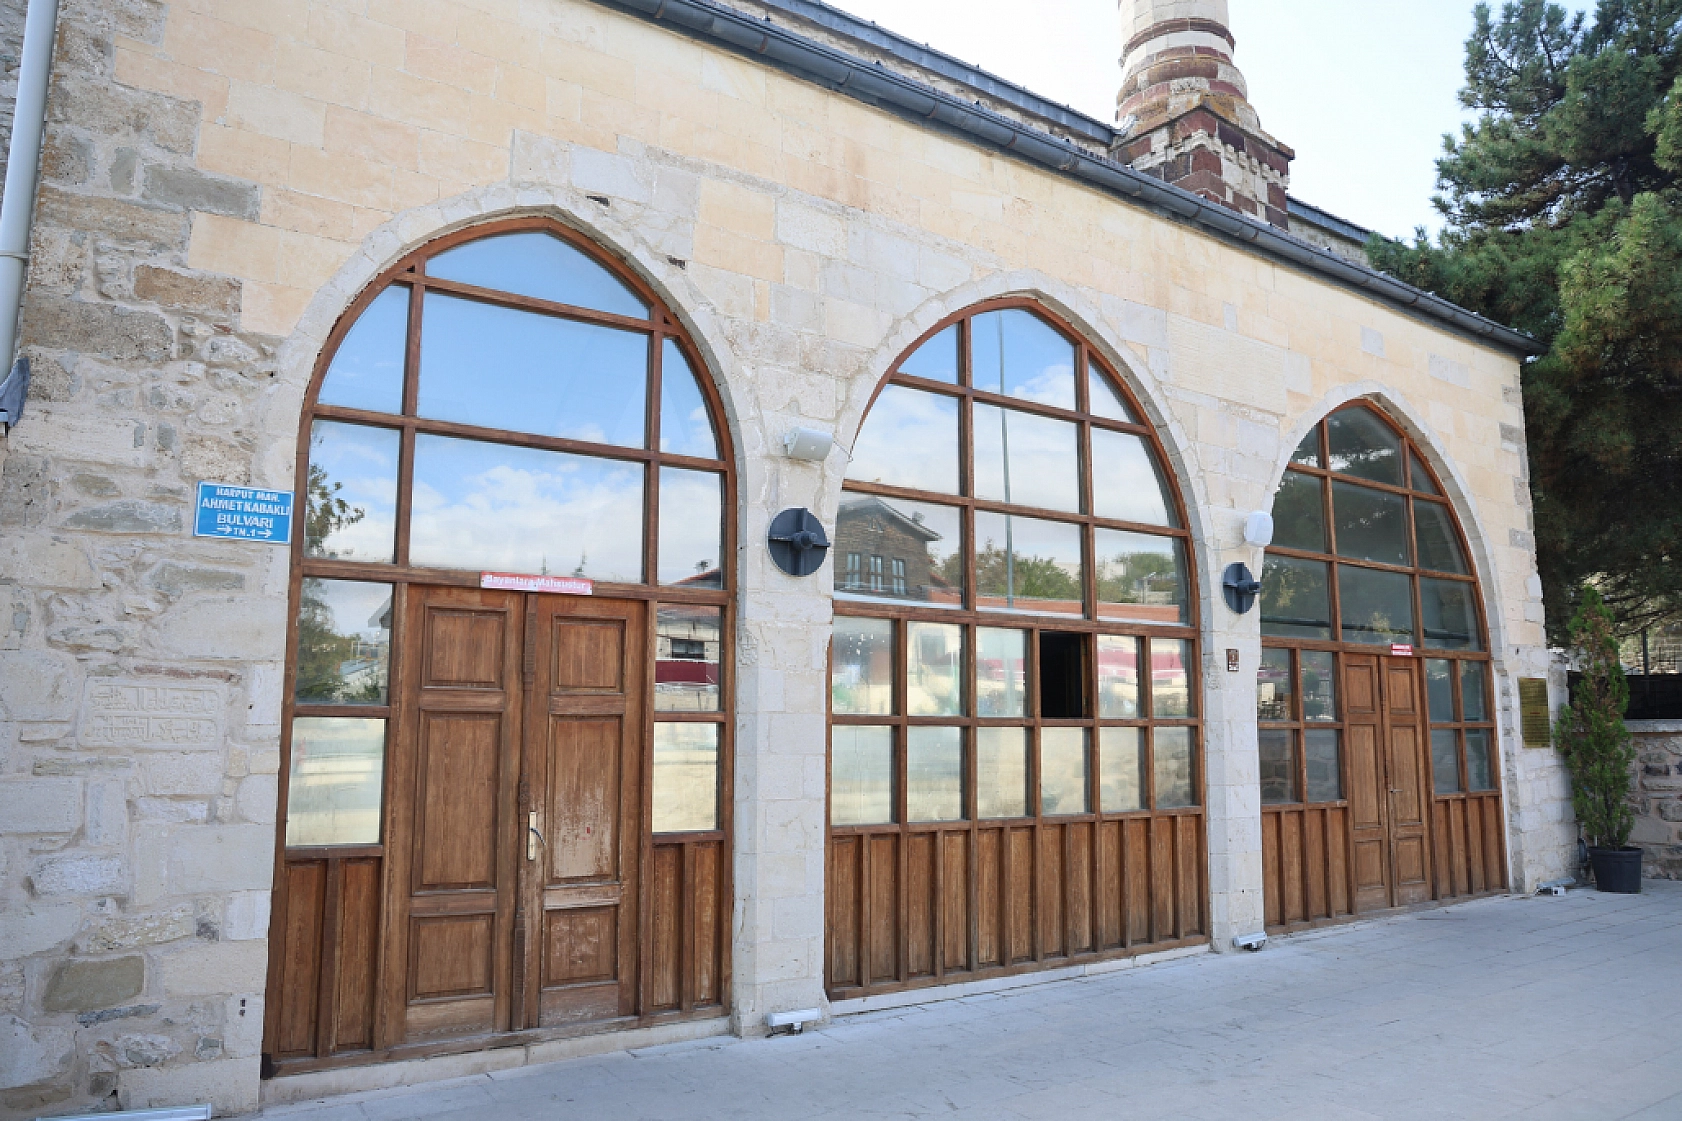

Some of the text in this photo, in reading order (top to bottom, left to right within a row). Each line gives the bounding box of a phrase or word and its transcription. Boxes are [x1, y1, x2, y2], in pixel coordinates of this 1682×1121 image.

[216, 487, 280, 502] HARPUT MAH.
[216, 513, 274, 529] BULVARI
